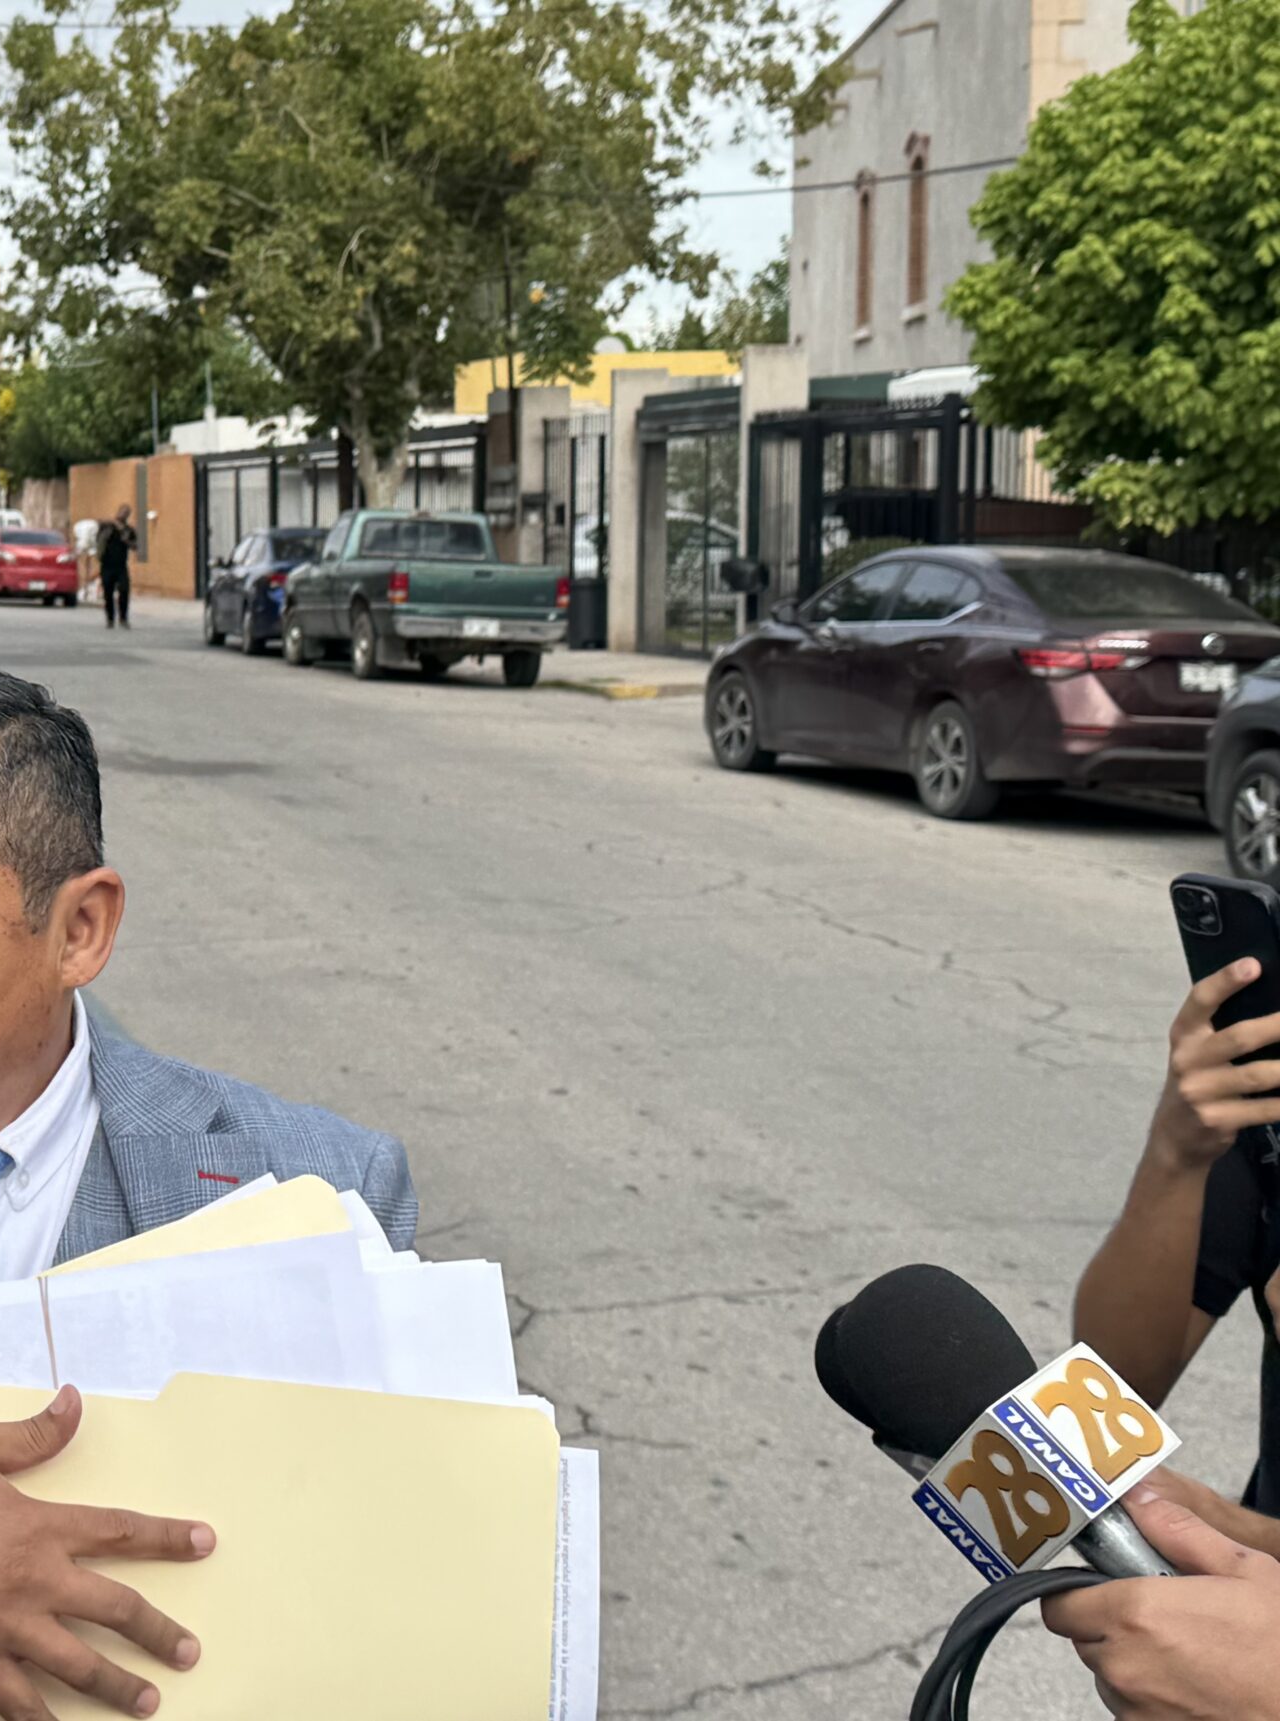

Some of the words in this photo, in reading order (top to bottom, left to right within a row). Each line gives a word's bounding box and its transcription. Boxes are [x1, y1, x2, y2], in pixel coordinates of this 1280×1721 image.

[1005, 1404, 1097, 1502] CANAL
[1030, 1357, 1164, 1486] 28
[923, 1490, 1007, 1581] CANAL
[943, 1429, 1071, 1568] 28
